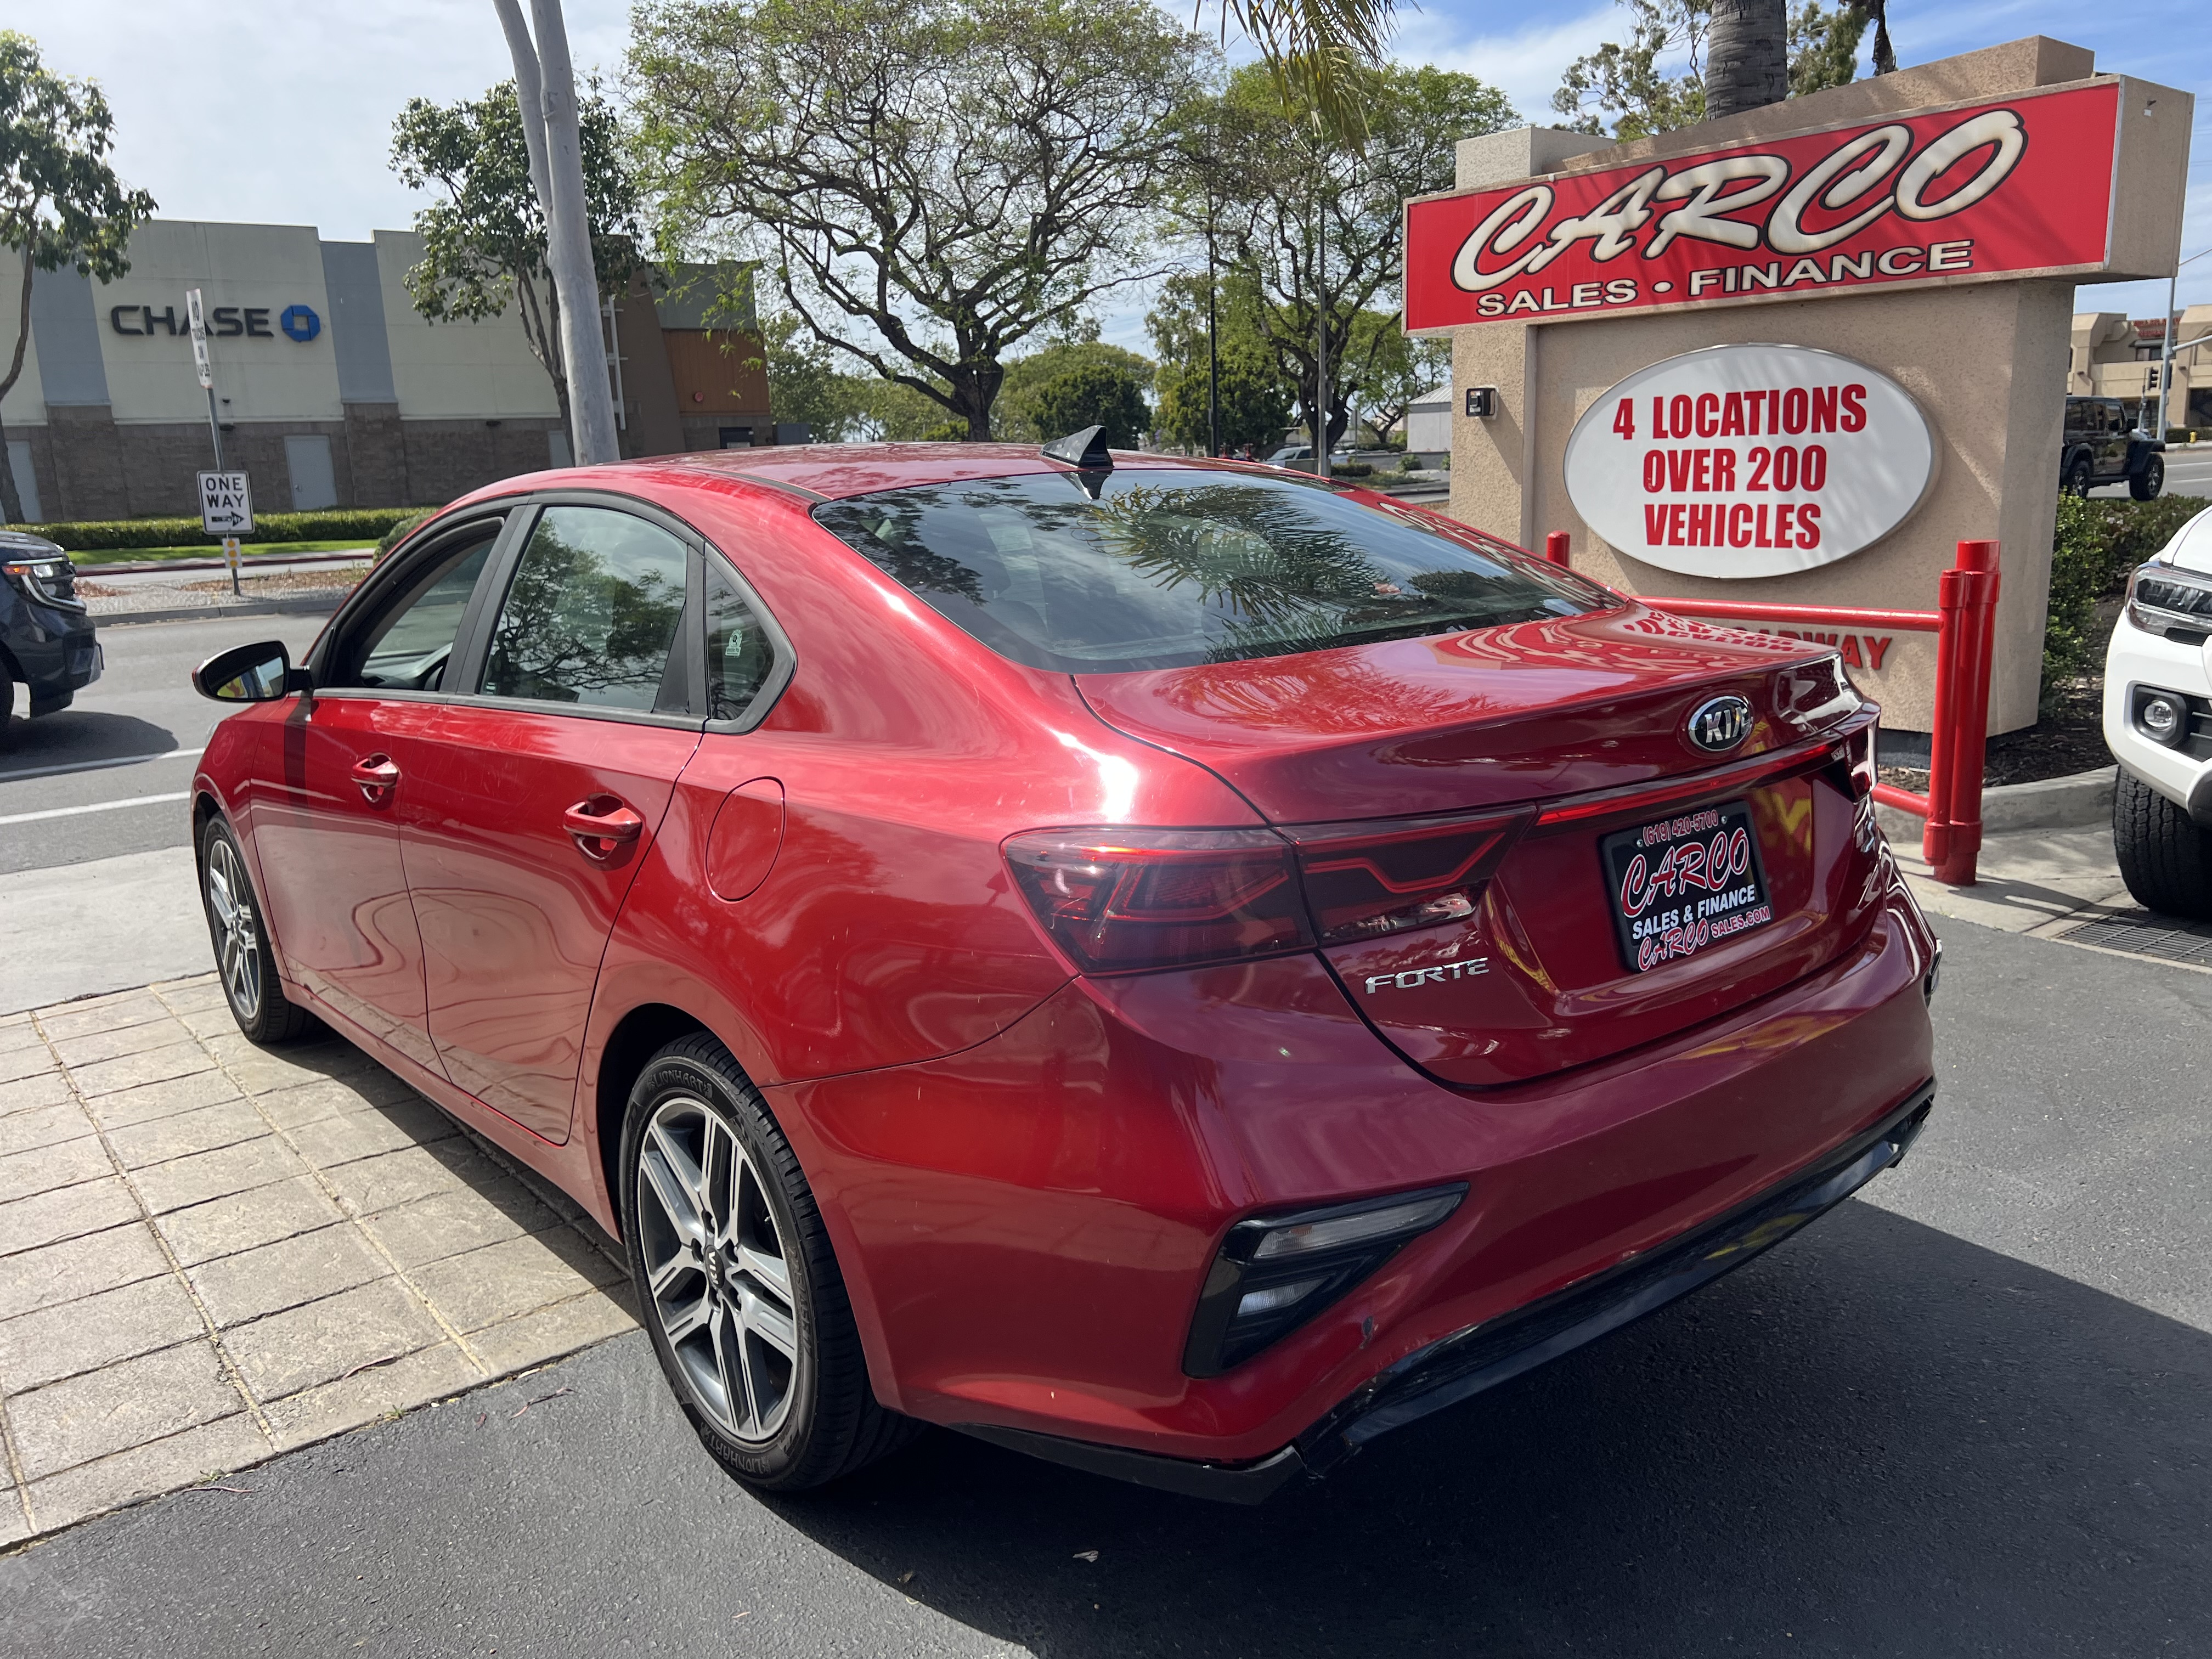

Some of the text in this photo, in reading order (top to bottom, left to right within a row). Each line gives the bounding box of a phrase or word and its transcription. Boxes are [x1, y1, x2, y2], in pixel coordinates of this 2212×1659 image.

[1451, 109, 2027, 292] CARCO
[1477, 239, 1975, 317] SALES FINANCE
[1613, 383, 1867, 441] 4 LOCATIONS
[206, 477, 242, 491] ONE
[1644, 444, 1827, 493] OVER 200
[207, 494, 244, 508] WAY
[1644, 503, 1821, 550] VEHICLES
[1704, 707, 1750, 743] KIA
[1643, 809, 1718, 847] (619) 420-5700
[1621, 827, 1749, 918] CARCO
[1633, 884, 1755, 939] SALES & FINANCE
[1638, 906, 1771, 971] CARCO SALES.COM
[1365, 957, 1489, 995] FORTE
[653, 1070, 703, 1093] LIONHART
[708, 1251, 719, 1285] KIA
[708, 1435, 763, 1474] LIONHART
